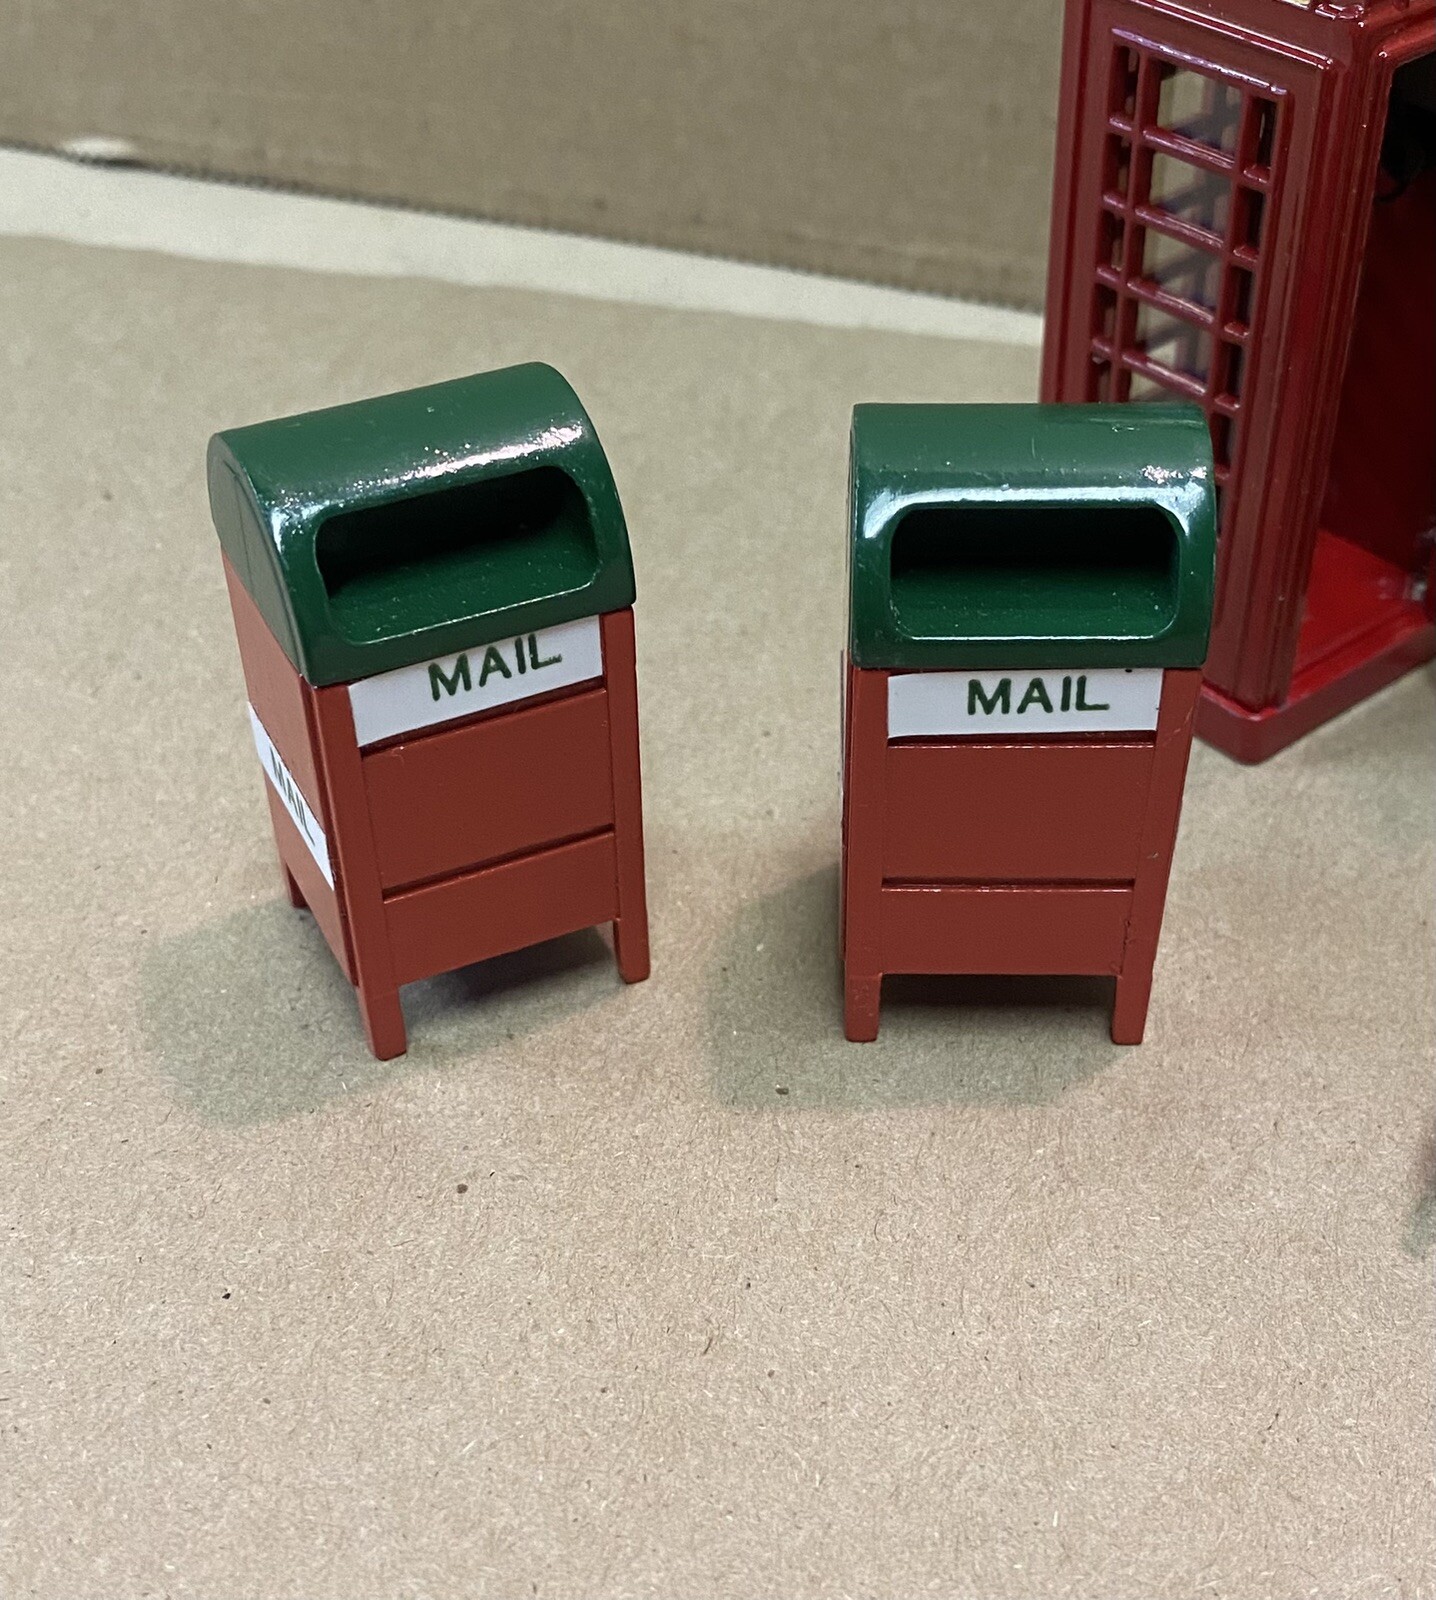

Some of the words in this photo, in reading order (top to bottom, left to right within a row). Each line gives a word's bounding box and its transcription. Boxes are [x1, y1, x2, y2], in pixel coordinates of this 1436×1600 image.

[428, 633, 563, 702] MAIL
[967, 675, 1110, 715] MAIL
[269, 745, 316, 847] MAIL
